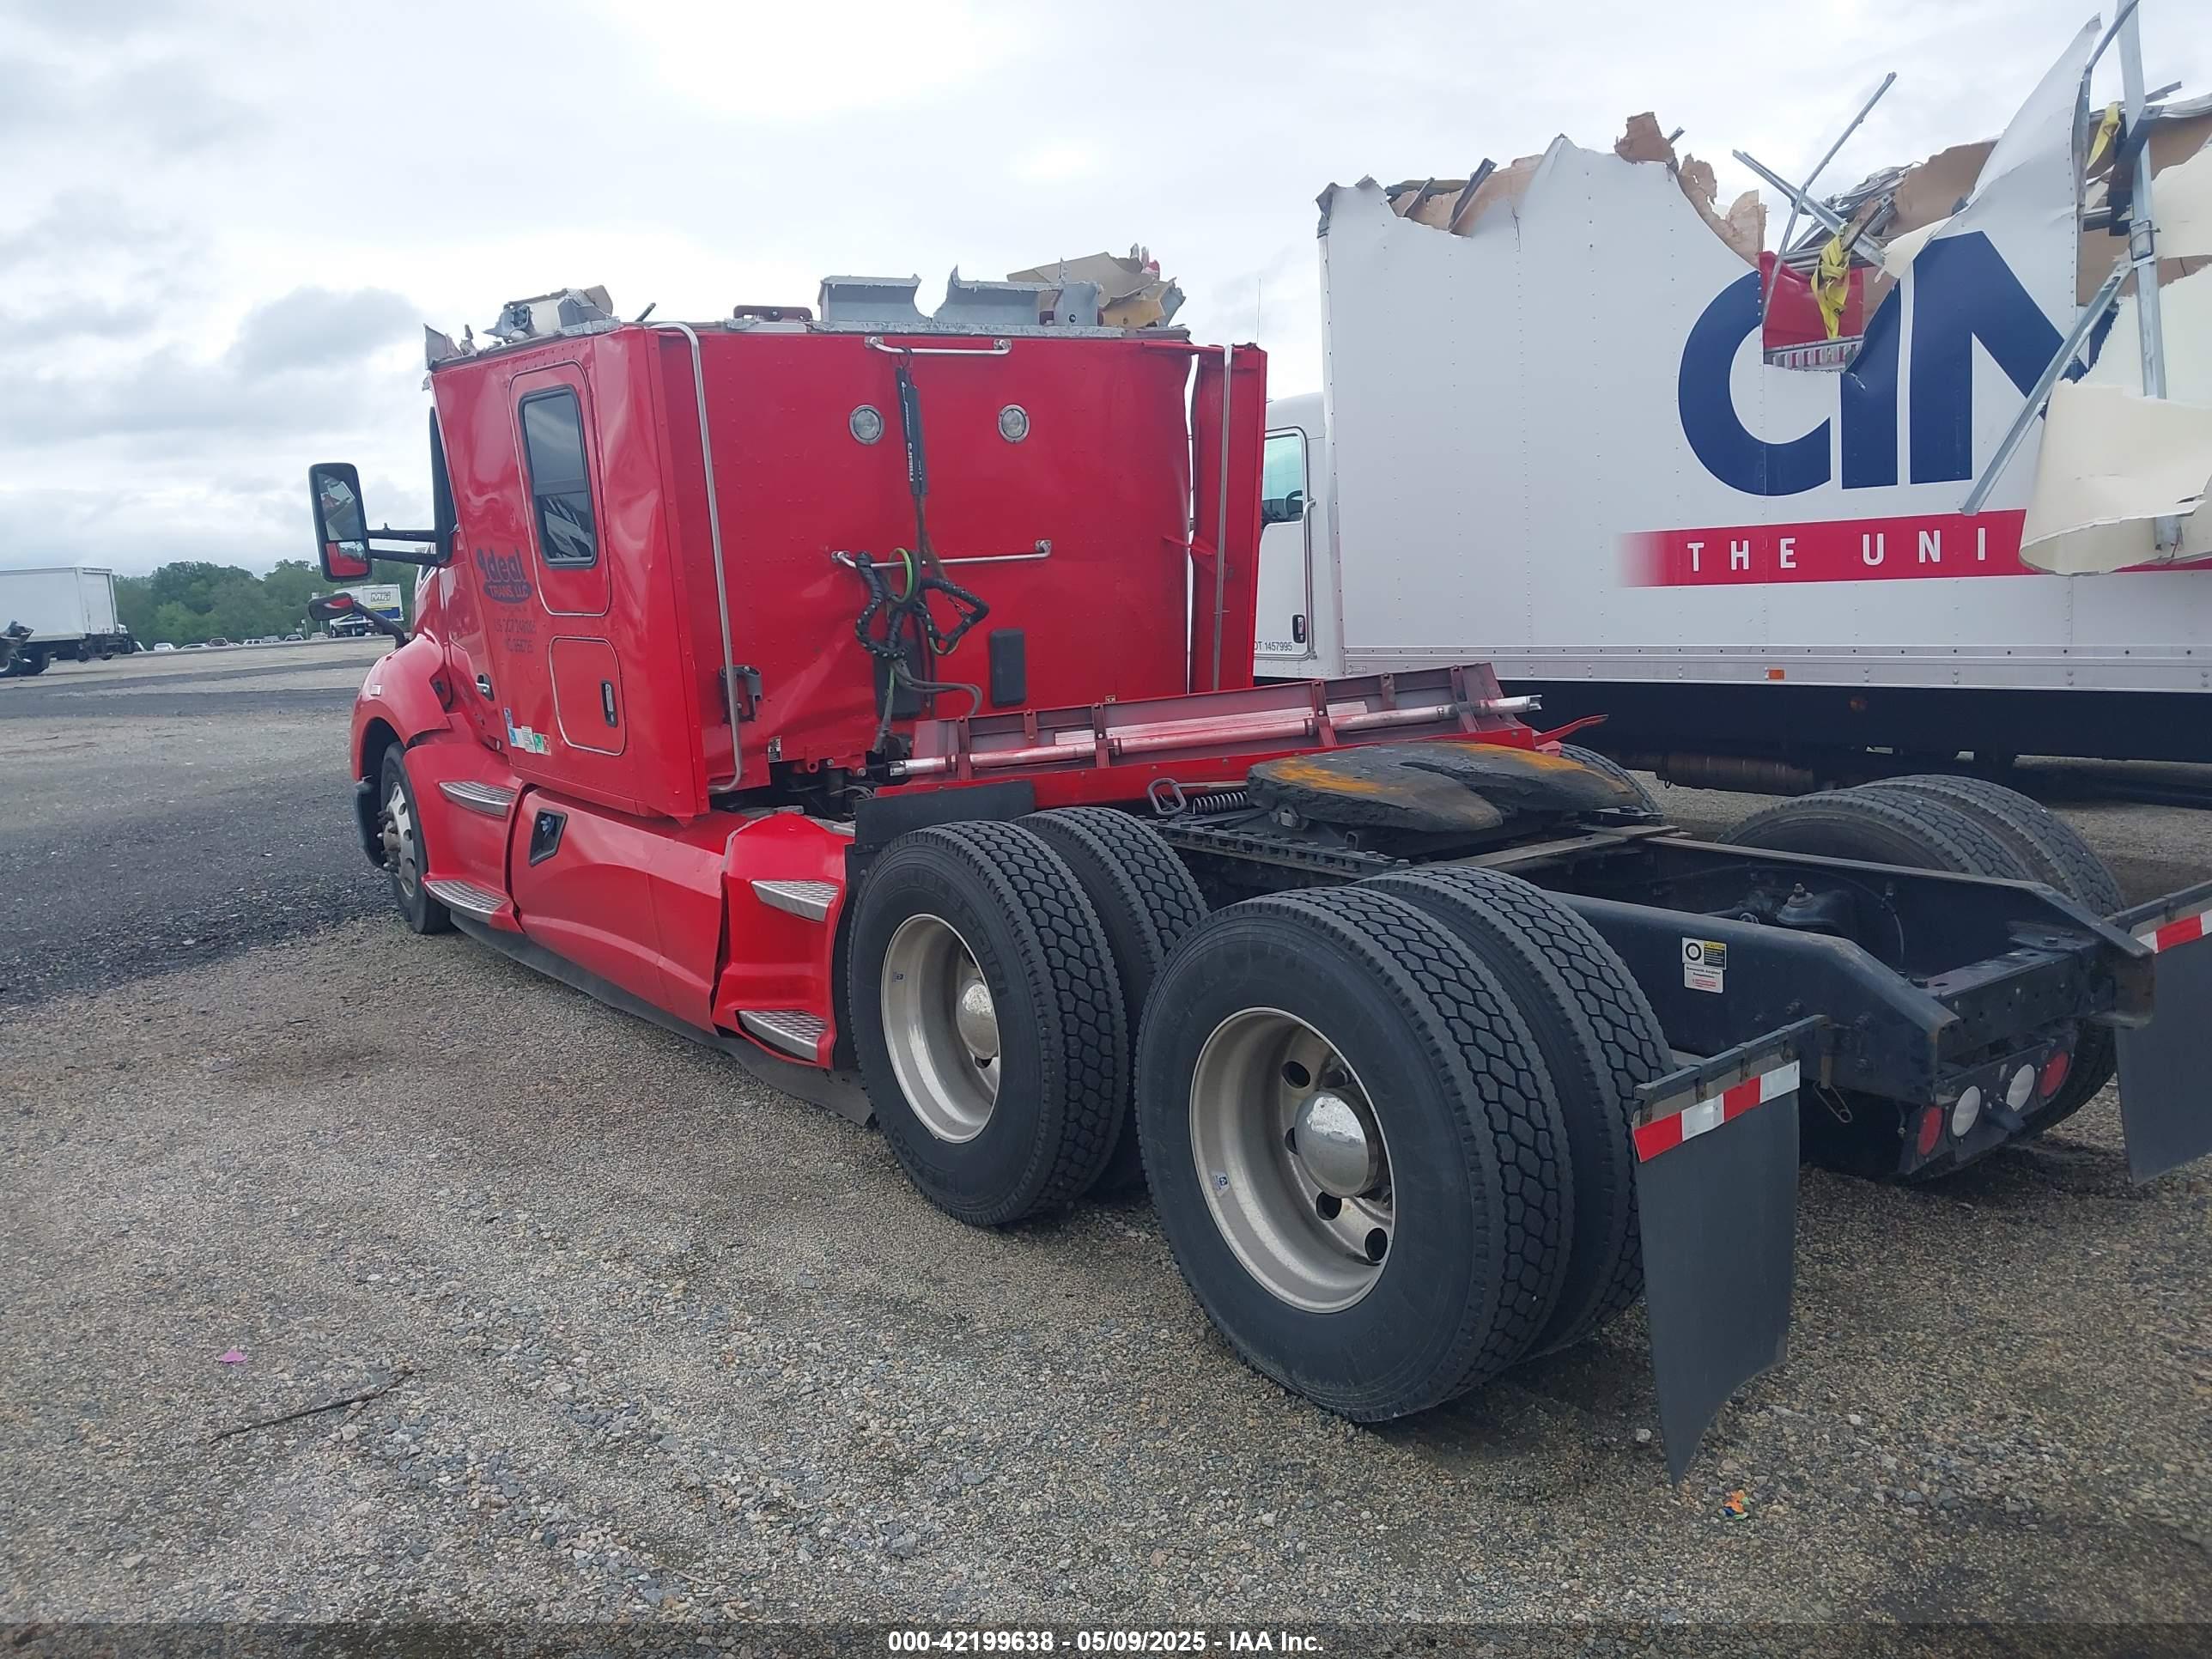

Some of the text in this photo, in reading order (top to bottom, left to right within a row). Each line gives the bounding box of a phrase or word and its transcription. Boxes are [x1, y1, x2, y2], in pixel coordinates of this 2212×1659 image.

[1687, 527, 1986, 571] THE UNI
[1265, 641, 1293, 652] 1457995
